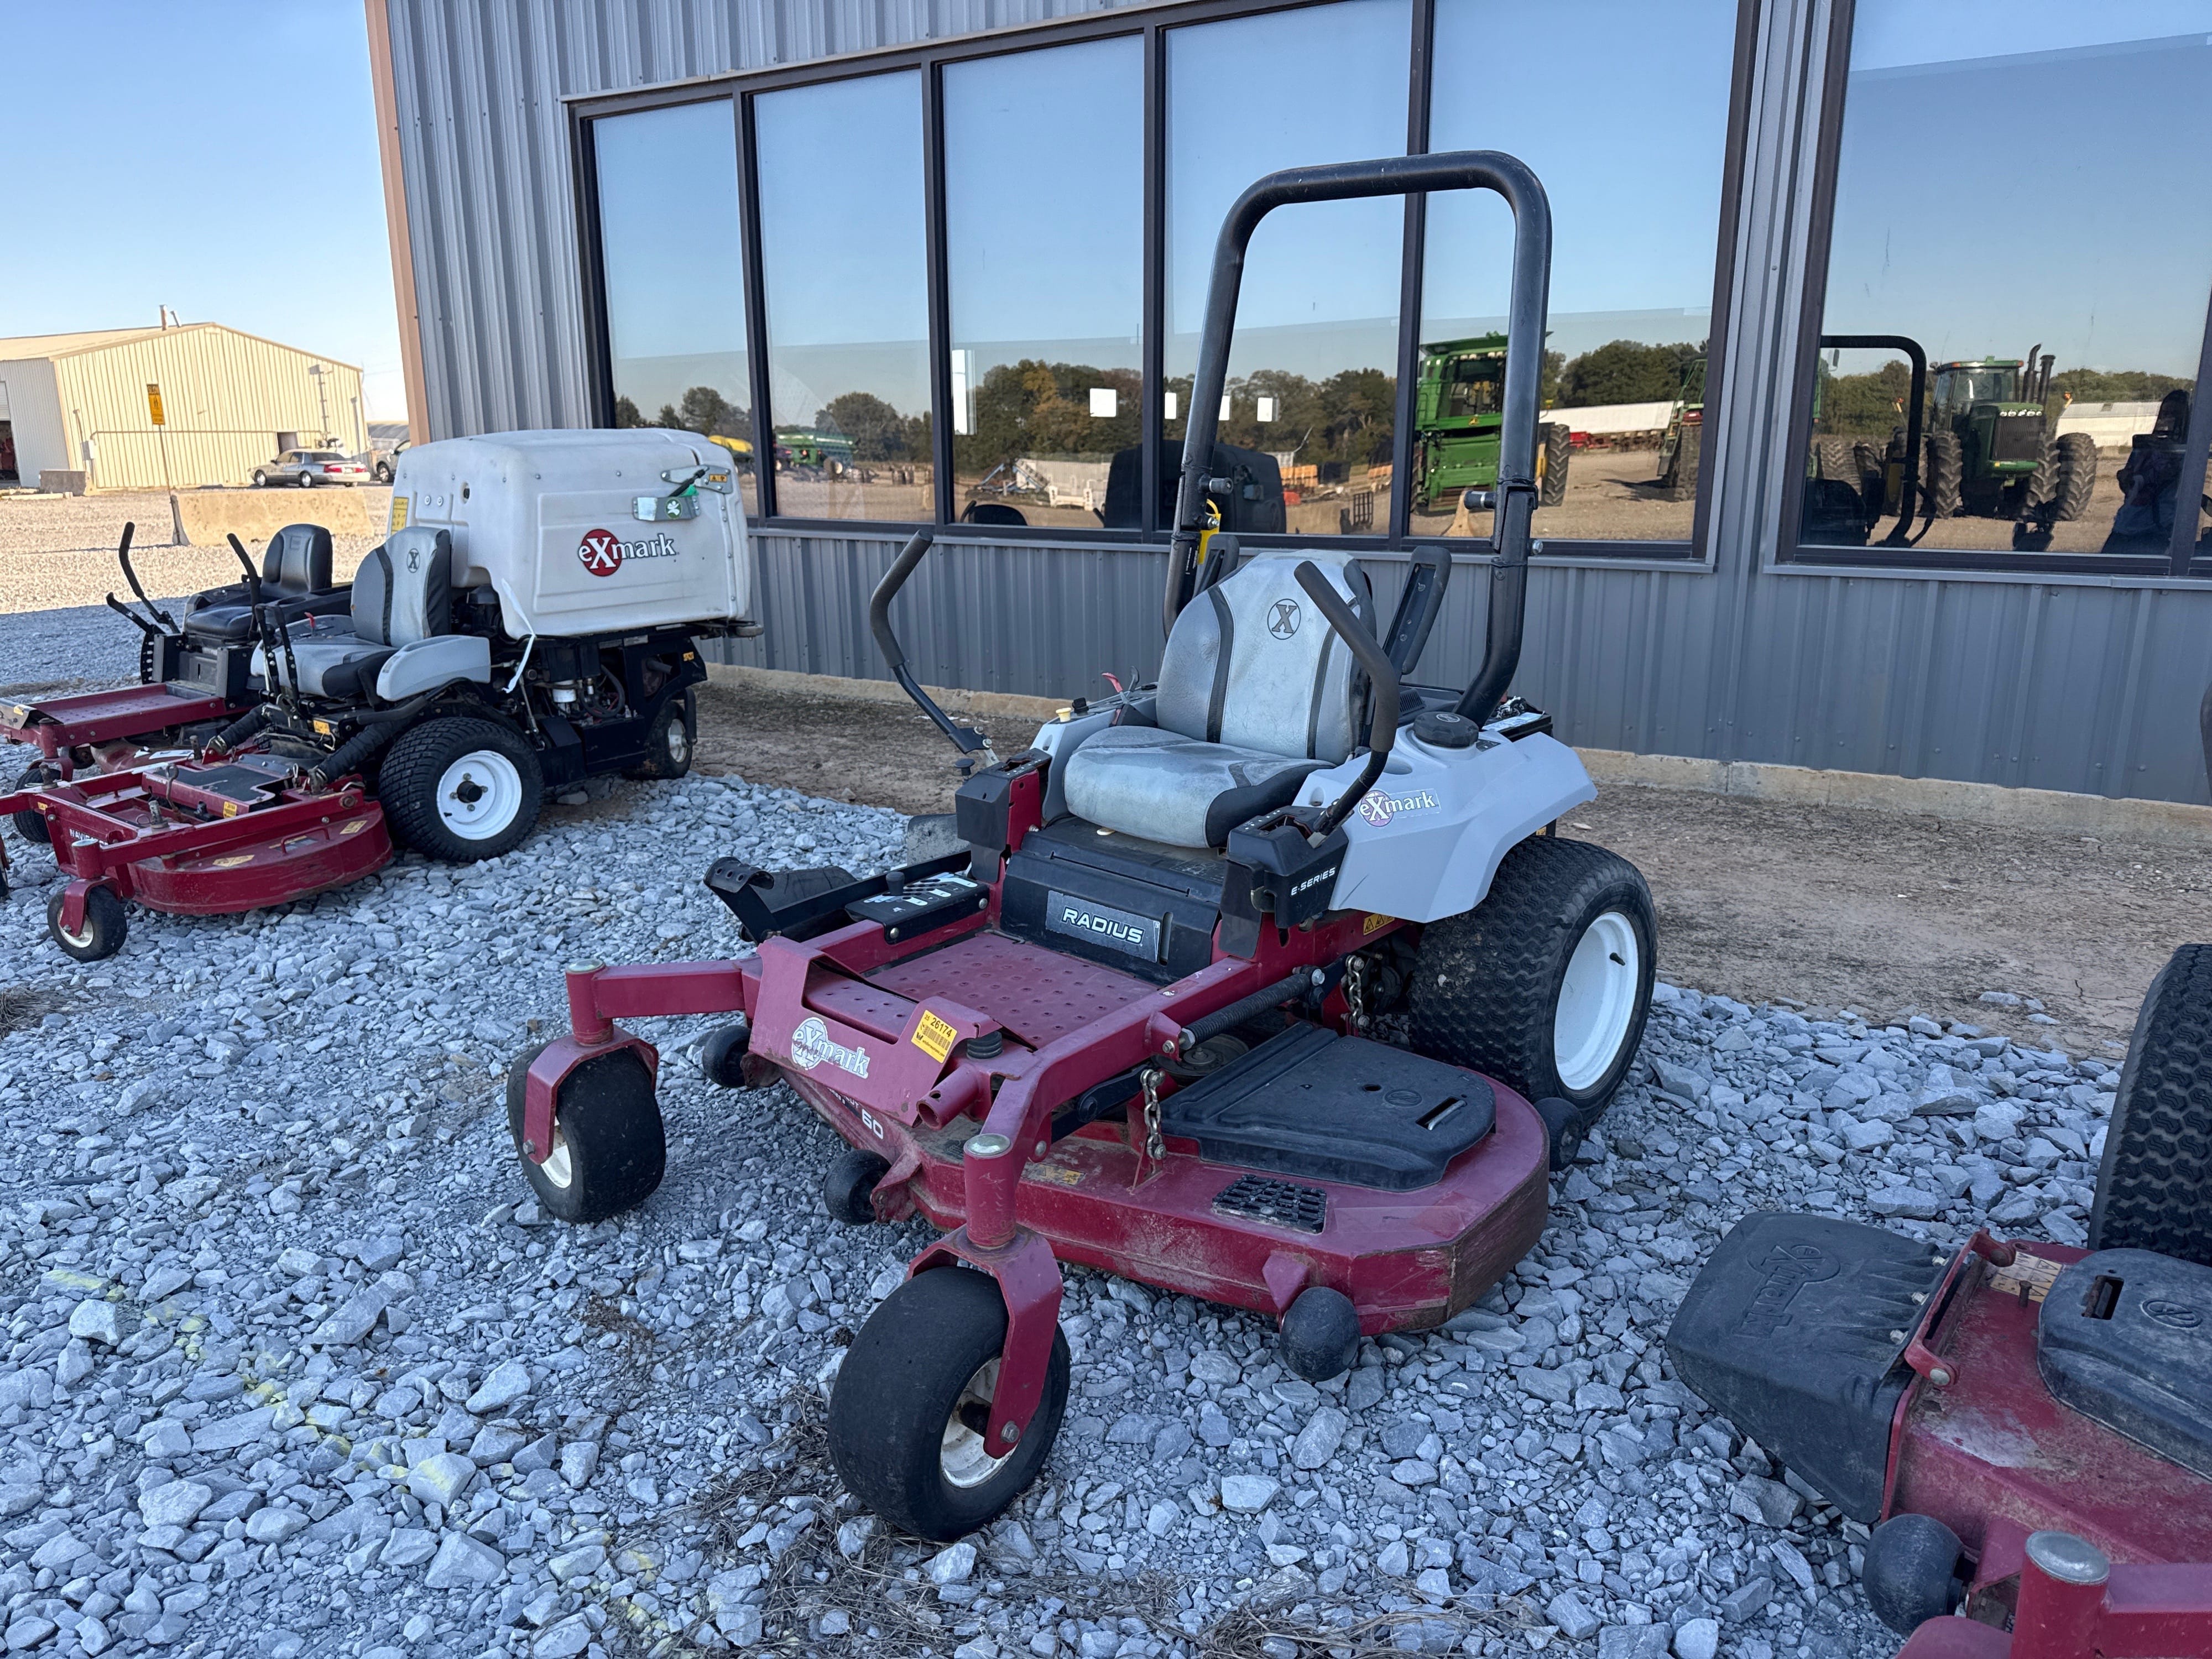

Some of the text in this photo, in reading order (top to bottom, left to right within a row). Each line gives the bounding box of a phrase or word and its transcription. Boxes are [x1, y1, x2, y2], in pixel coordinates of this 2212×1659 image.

[578, 533, 677, 570] eXmark
[1271, 604, 1297, 634] X
[1359, 791, 1437, 822] eXmark
[1062, 906, 1145, 945] RADIUS
[930, 1017, 952, 1037] 26174
[862, 1108, 884, 1140] 60
